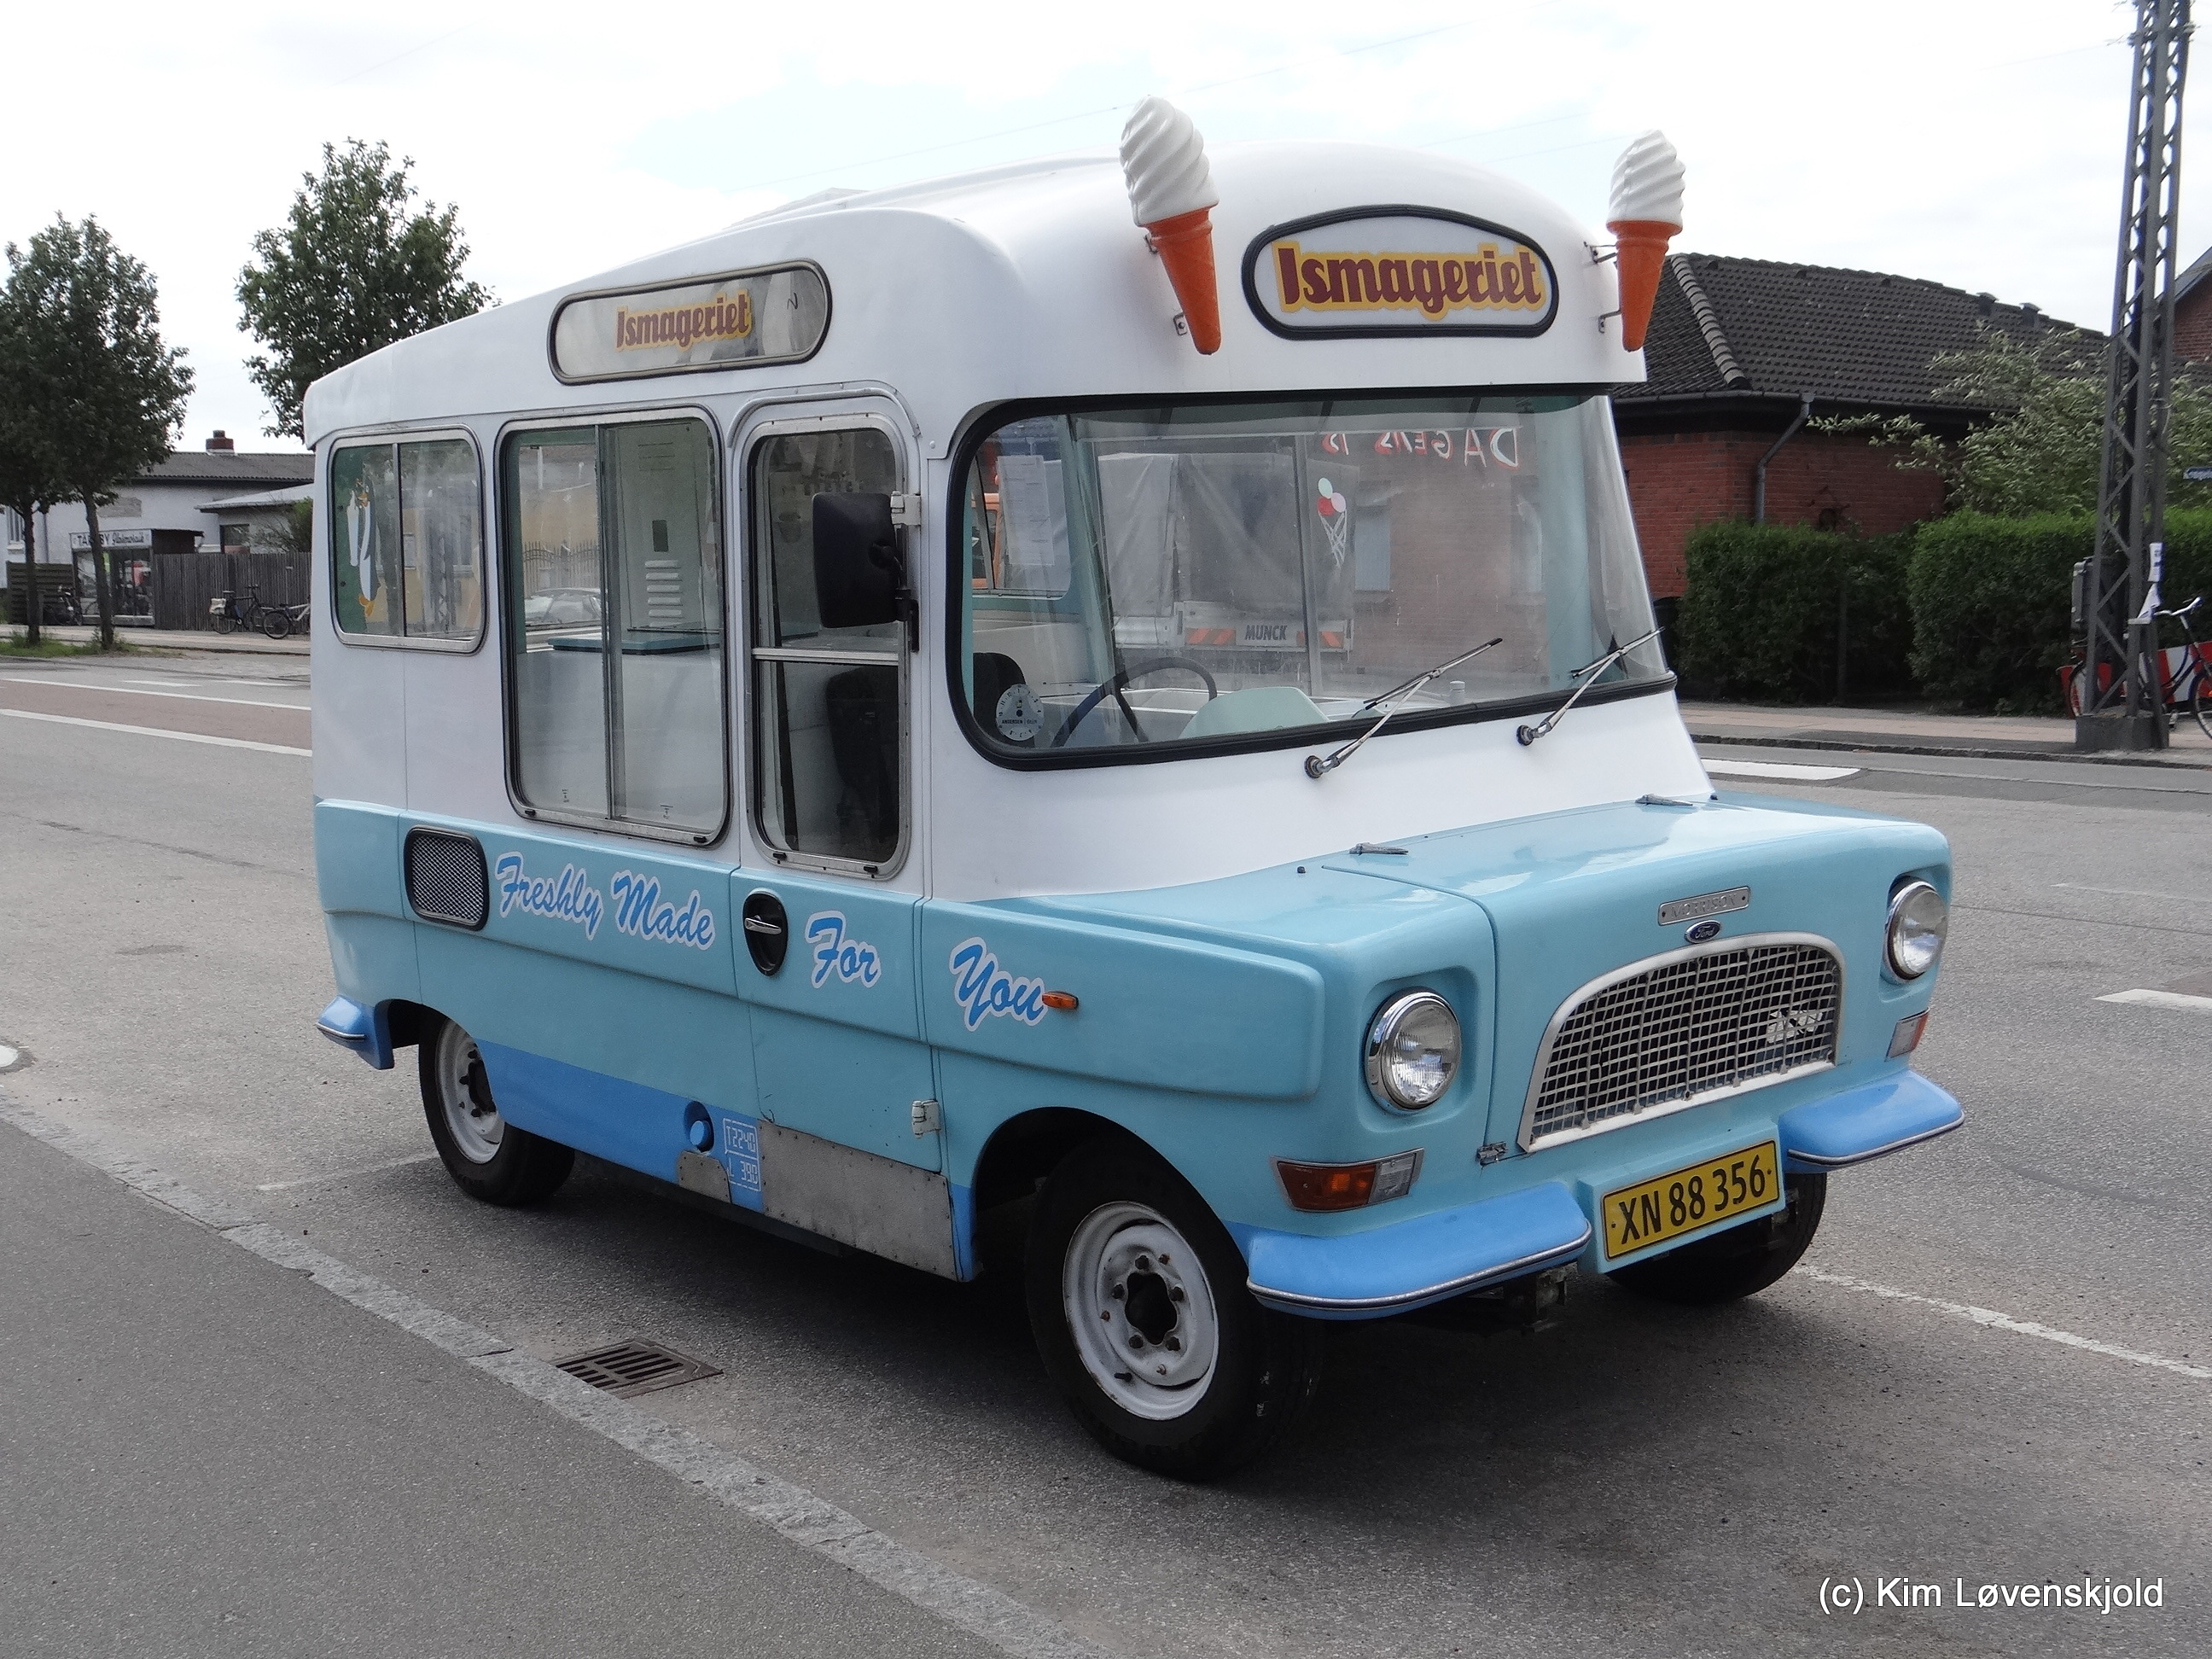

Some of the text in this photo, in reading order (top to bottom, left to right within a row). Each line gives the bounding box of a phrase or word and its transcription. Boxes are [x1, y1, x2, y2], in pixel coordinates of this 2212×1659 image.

[1278, 247, 1541, 314] Ismageriet
[616, 293, 750, 349] Ismageriet
[1244, 624, 1289, 642] MUNCK
[497, 854, 1045, 1027] Freshly Made For You
[1694, 924, 1716, 940] Ford
[1618, 1154, 1766, 1245] XN 88 356
